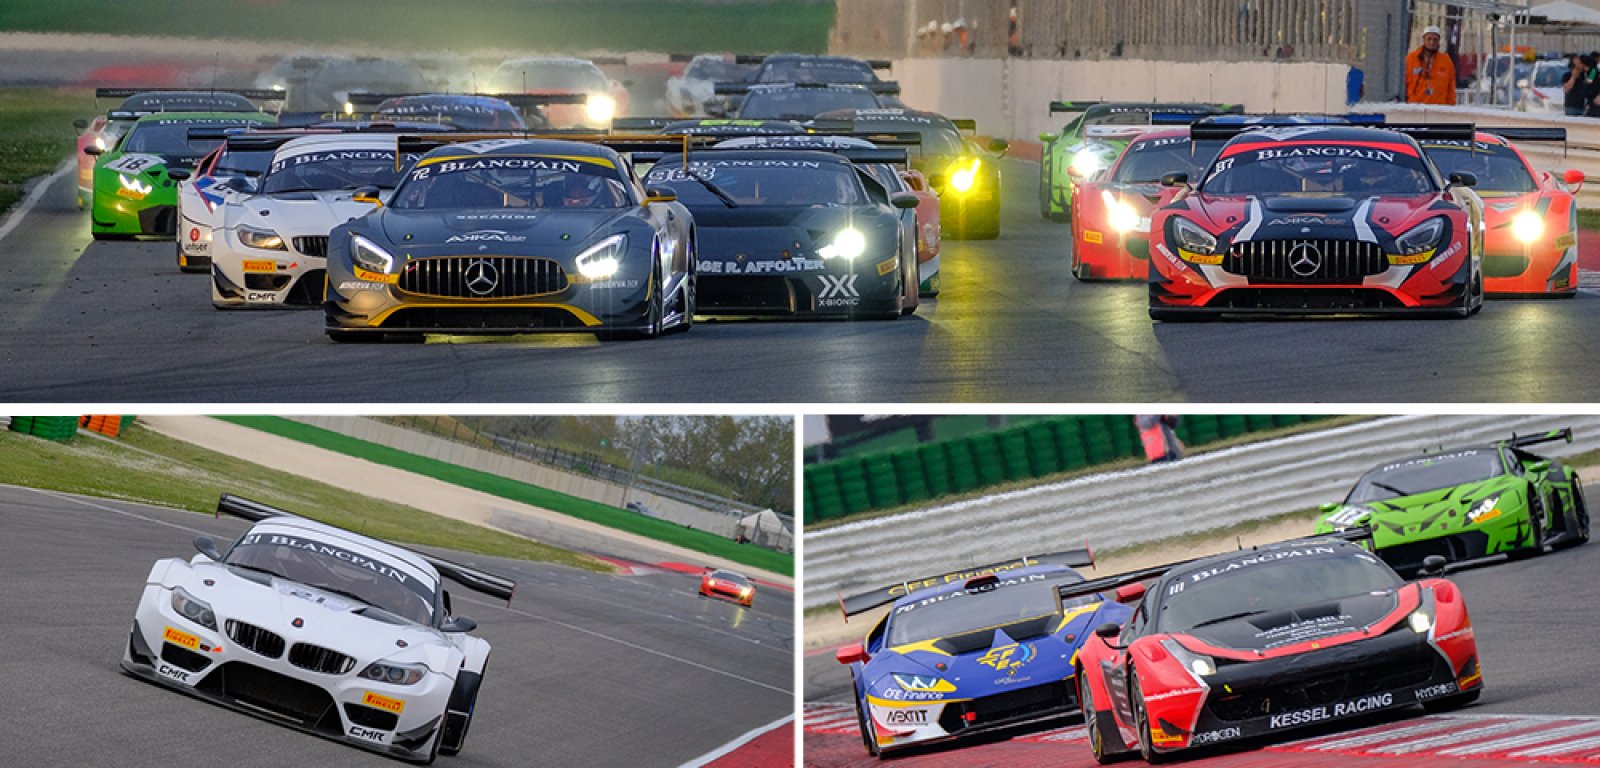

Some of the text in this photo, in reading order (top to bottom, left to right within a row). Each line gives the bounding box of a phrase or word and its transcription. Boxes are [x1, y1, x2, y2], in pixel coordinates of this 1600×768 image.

[1257, 148, 1395, 162] BLANCPAIN
[412, 159, 581, 181] 72 BLANCPAIN
[745, 257, 825, 273] AFFOLTER
[271, 535, 407, 584] BLANCPAIN
[1191, 545, 1335, 583] BLANCPAIN
[166, 628, 197, 647] PIRELLI
[159, 665, 190, 682] CMR
[367, 693, 401, 711] PIRELLI
[1270, 694, 1393, 729] KESSEL RACING
[349, 726, 385, 742] CMR
